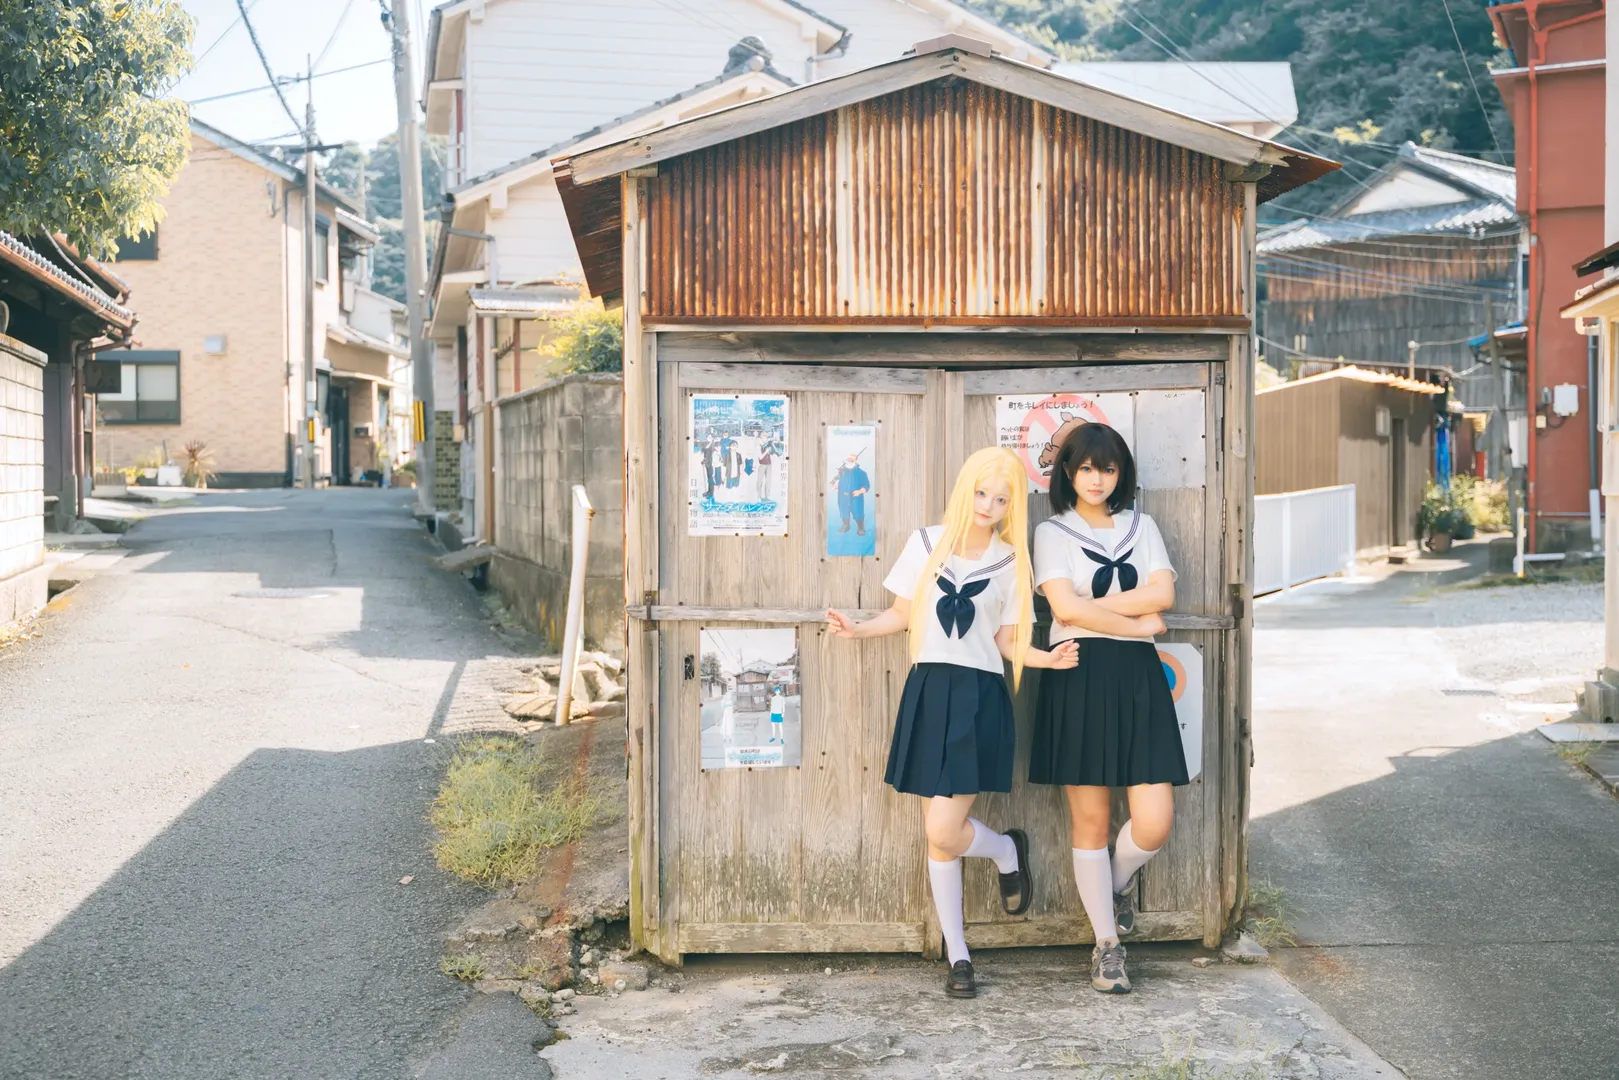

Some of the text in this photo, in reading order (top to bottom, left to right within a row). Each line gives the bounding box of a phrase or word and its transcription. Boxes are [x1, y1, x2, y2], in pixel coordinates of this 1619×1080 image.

[1008, 401, 1094, 410] 町をキレイにしましょう！
[701, 497, 776, 513] サマータイムレンダ
